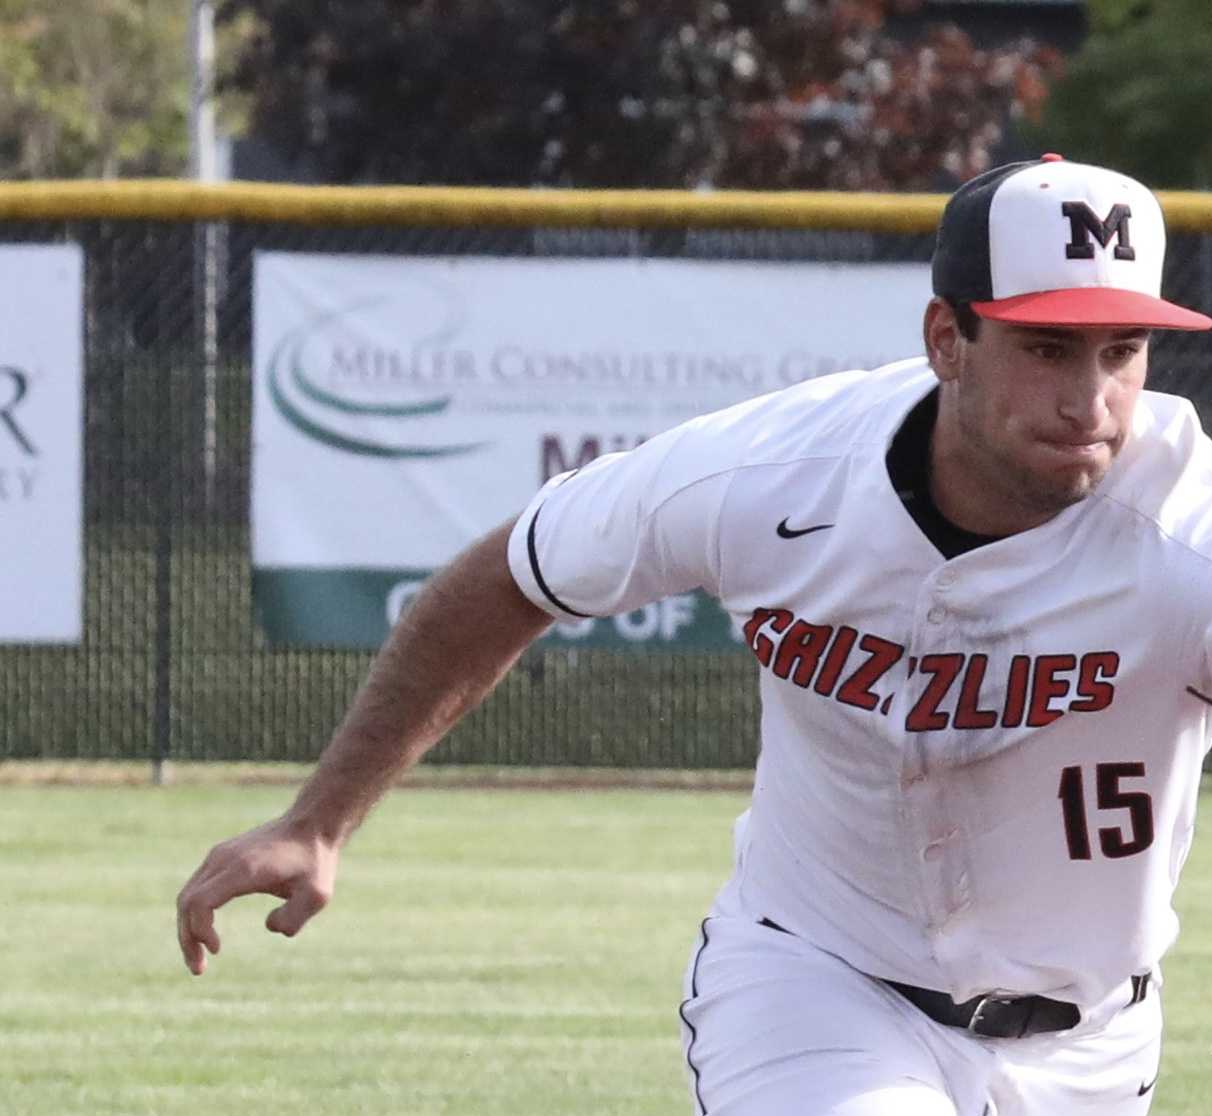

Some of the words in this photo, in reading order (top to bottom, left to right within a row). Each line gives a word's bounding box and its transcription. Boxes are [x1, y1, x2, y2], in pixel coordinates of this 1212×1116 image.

[1061, 200, 1136, 261] M
[614, 595, 696, 641] OF
[742, 607, 1120, 732] GRIZZLIES
[1058, 761, 1154, 861] 15
